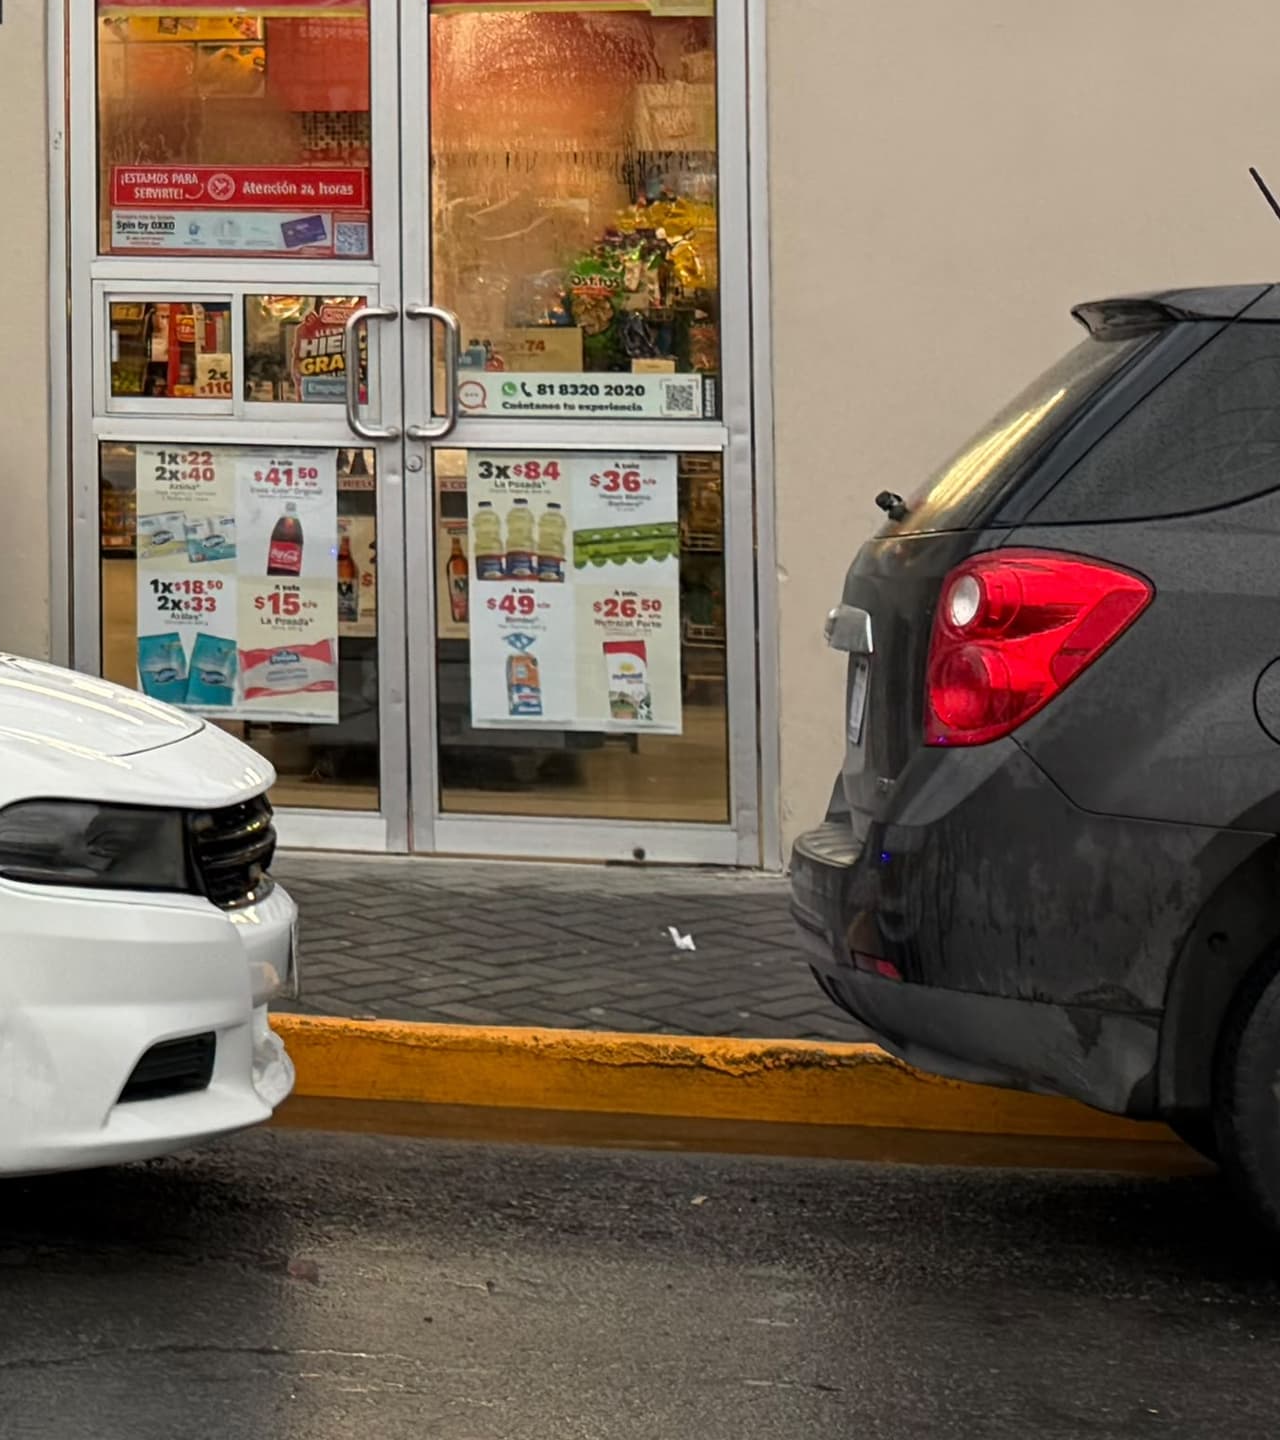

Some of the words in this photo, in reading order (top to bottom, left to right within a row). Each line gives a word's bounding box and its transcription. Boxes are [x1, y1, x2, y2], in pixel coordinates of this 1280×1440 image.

[171, 172, 199, 185] PARA
[242, 180, 297, 196] Atención
[319, 180, 354, 196] horas
[207, 369, 229, 381] 2x
[536, 383, 555, 398] 81
[558, 383, 600, 398] 8320
[604, 383, 646, 398] 2020
[477, 460, 561, 481] 3x$84
[589, 470, 641, 493] $36
[254, 592, 301, 616] $15
[486, 594, 535, 615] $49
